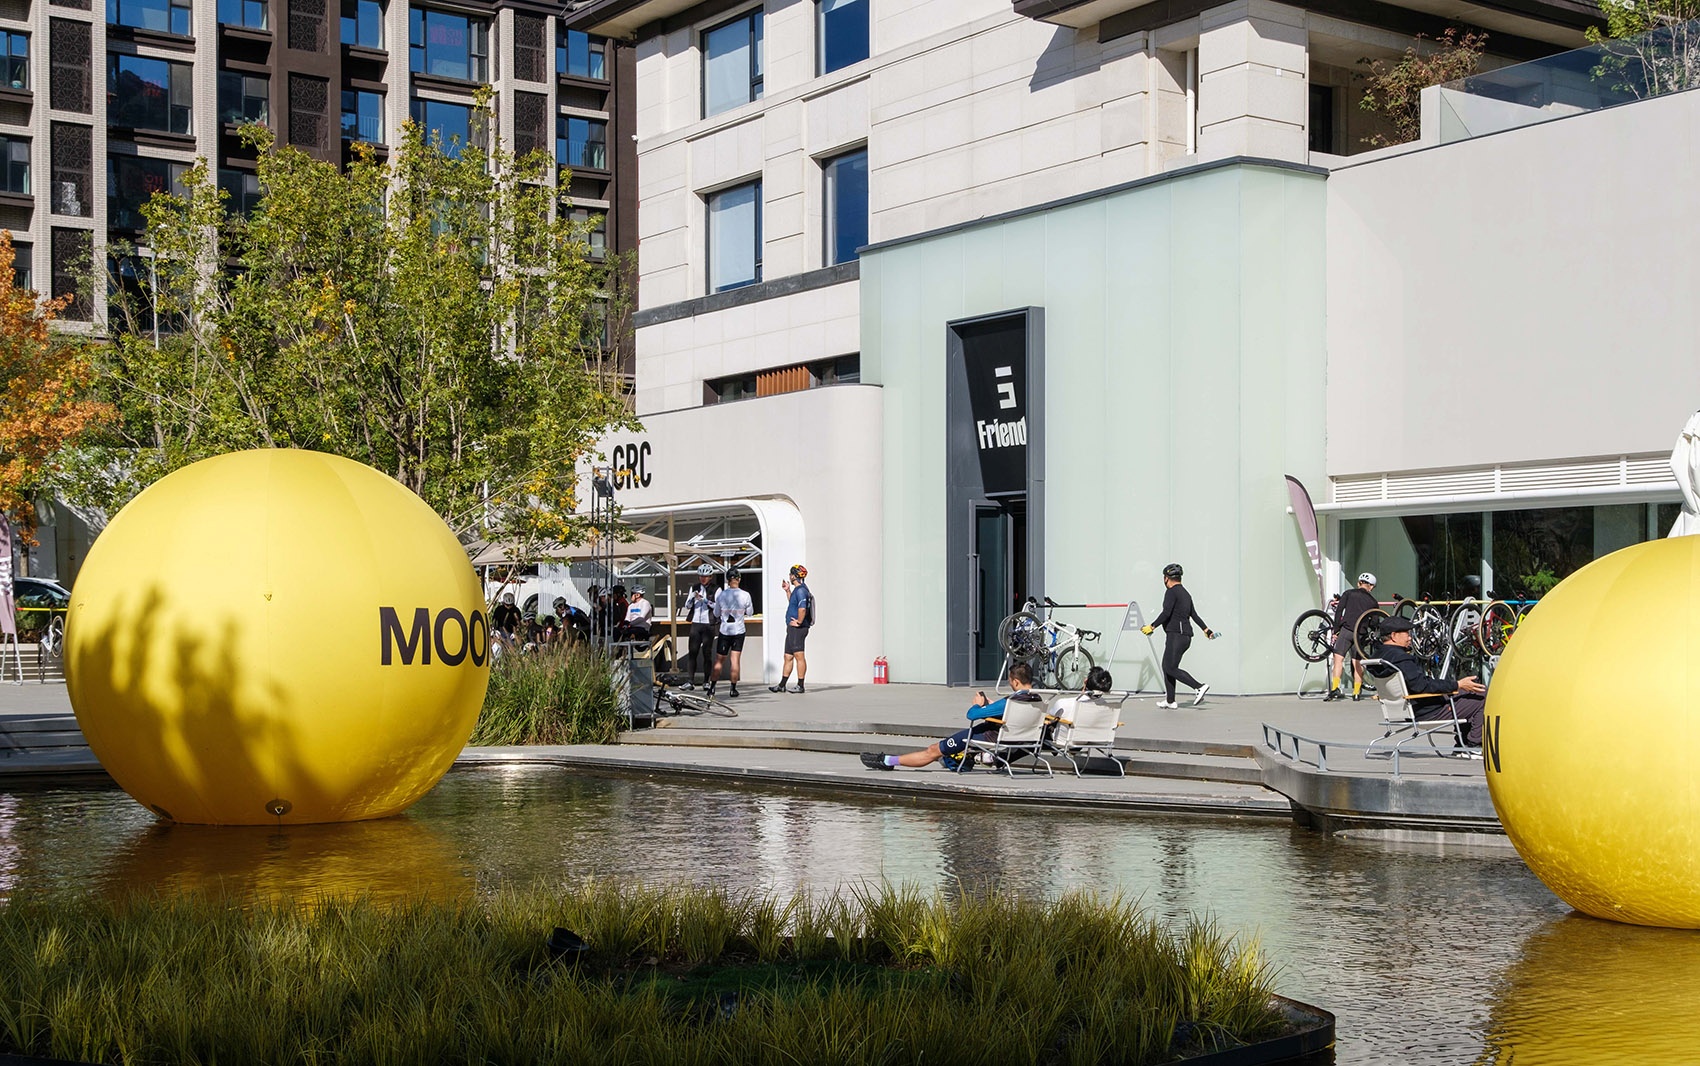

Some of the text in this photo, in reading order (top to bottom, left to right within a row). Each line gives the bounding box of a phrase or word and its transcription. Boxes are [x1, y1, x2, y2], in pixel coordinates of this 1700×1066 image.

[977, 416, 1027, 450] Friend
[613, 441, 652, 491] GRC
[379, 606, 490, 667] MOO
